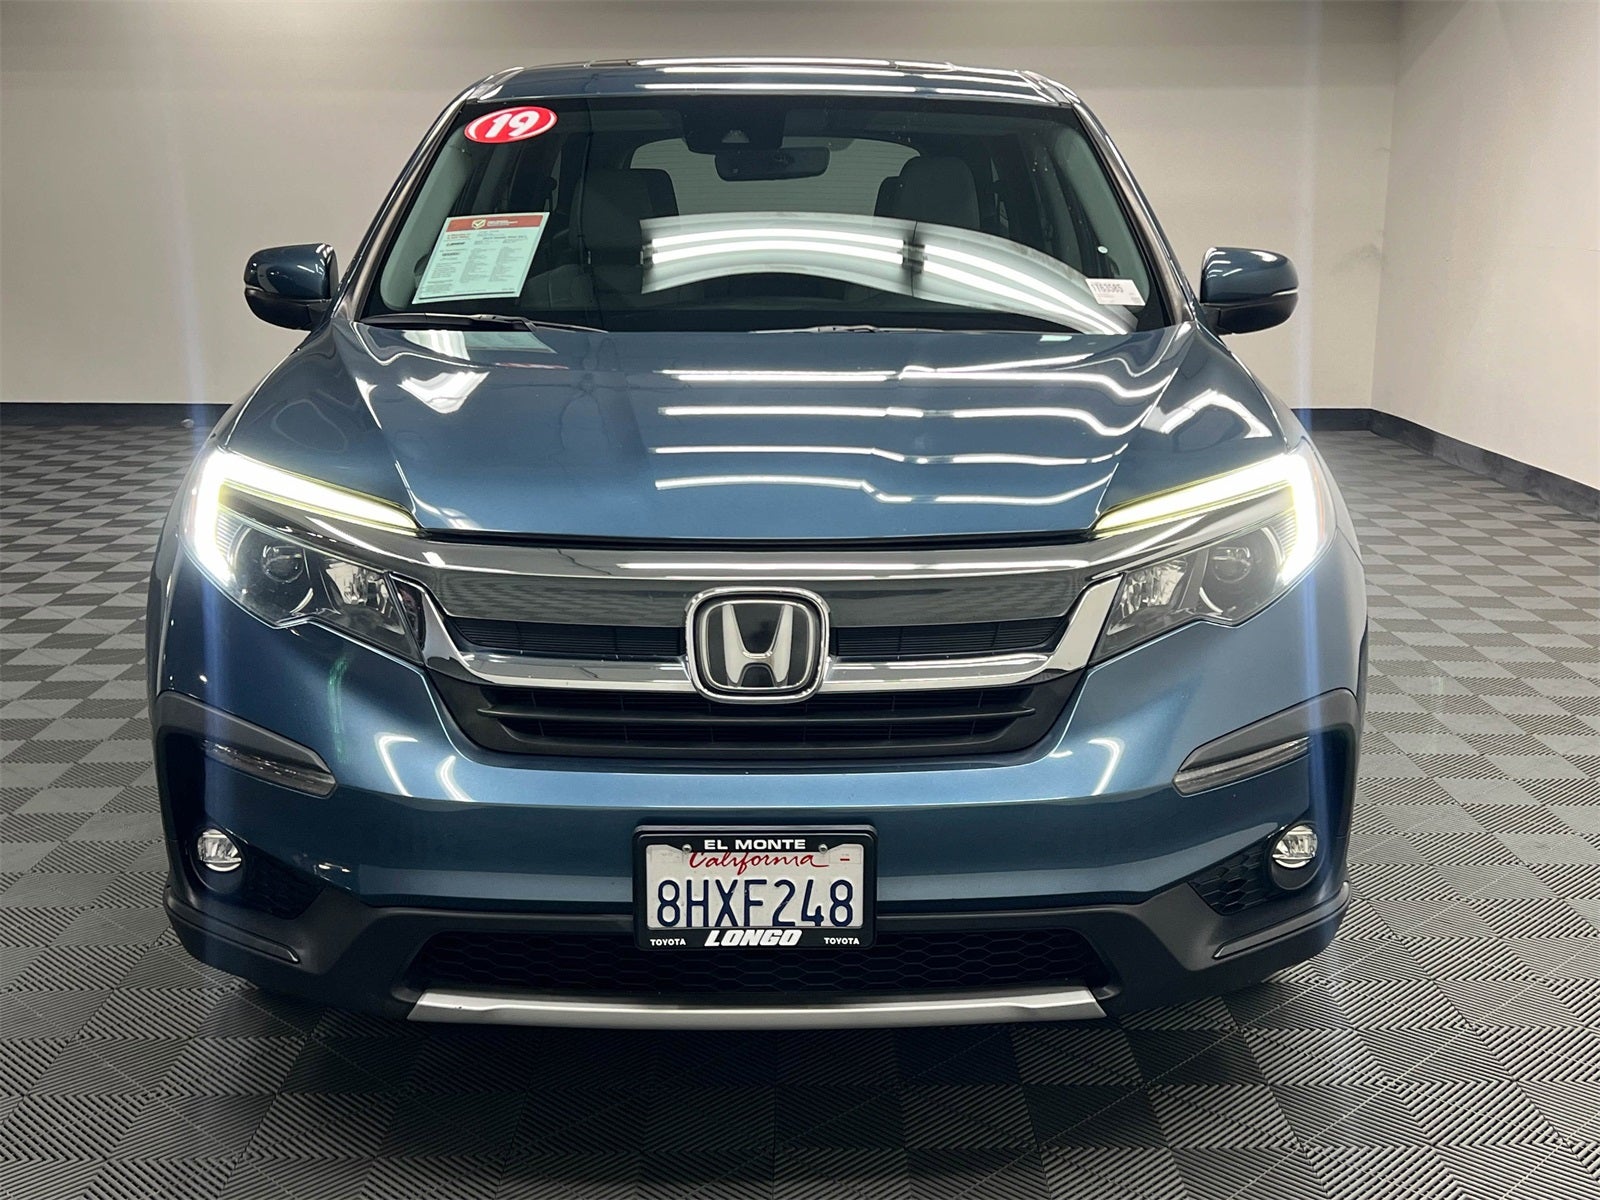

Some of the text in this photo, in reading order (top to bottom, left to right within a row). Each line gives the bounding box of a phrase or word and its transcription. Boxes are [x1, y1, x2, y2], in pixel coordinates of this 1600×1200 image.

[485, 110, 540, 138] 19
[704, 839, 806, 850] EL MONTE
[689, 851, 829, 876] California
[657, 879, 854, 928] 8HXF248
[650, 938, 687, 946] TOYOTA
[704, 929, 802, 947] LONGO
[824, 937, 860, 945] TOYOTA
